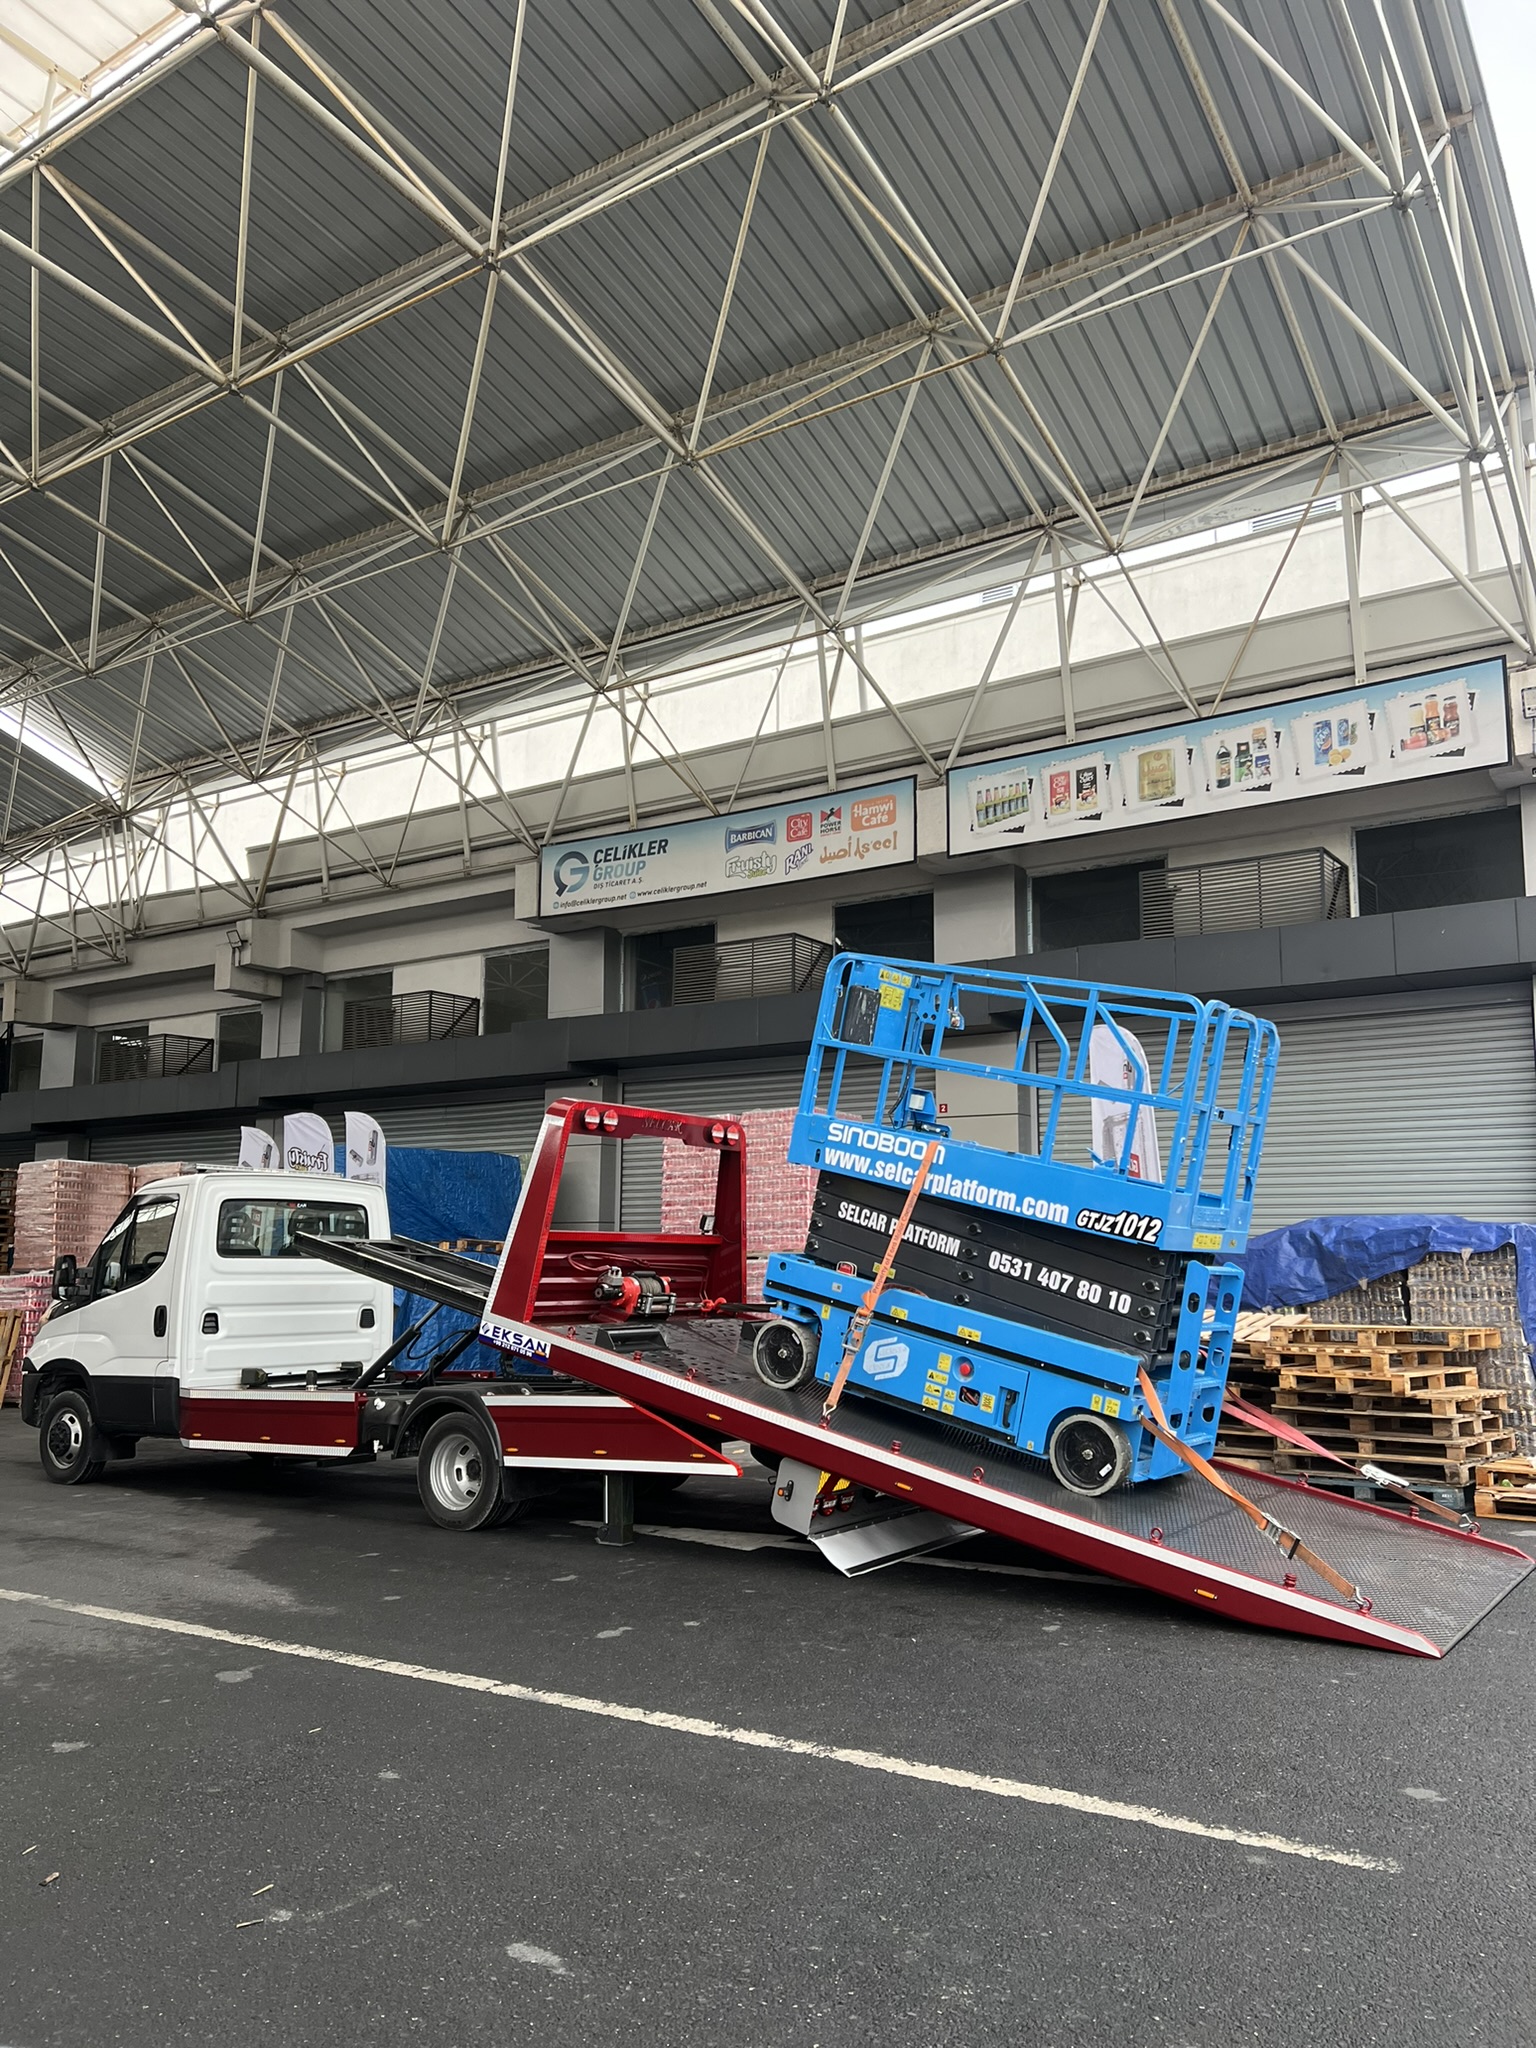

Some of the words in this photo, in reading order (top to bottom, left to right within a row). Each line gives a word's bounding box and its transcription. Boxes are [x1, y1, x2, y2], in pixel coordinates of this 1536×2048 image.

[853, 800, 894, 818] Hamwi
[861, 812, 889, 827] Café
[730, 827, 773, 844] BARBICAN
[820, 826, 842, 834] HORSE
[593, 860, 646, 881] GROUP
[725, 851, 777, 878] Fruisty
[785, 842, 813, 875] RANI
[637, 881, 707, 897] www.celiklergroup.net
[838, 1201, 887, 1233] SELCAR
[889, 1218, 961, 1257] PATFORM
[1076, 1209, 1163, 1243] GTJZ1012
[988, 1251, 1032, 1281] 0531
[1037, 1267, 1074, 1294] 407
[1076, 1281, 1102, 1304] 80
[1108, 1291, 1132, 1314] 10
[492, 1326, 547, 1353] EKSAN
